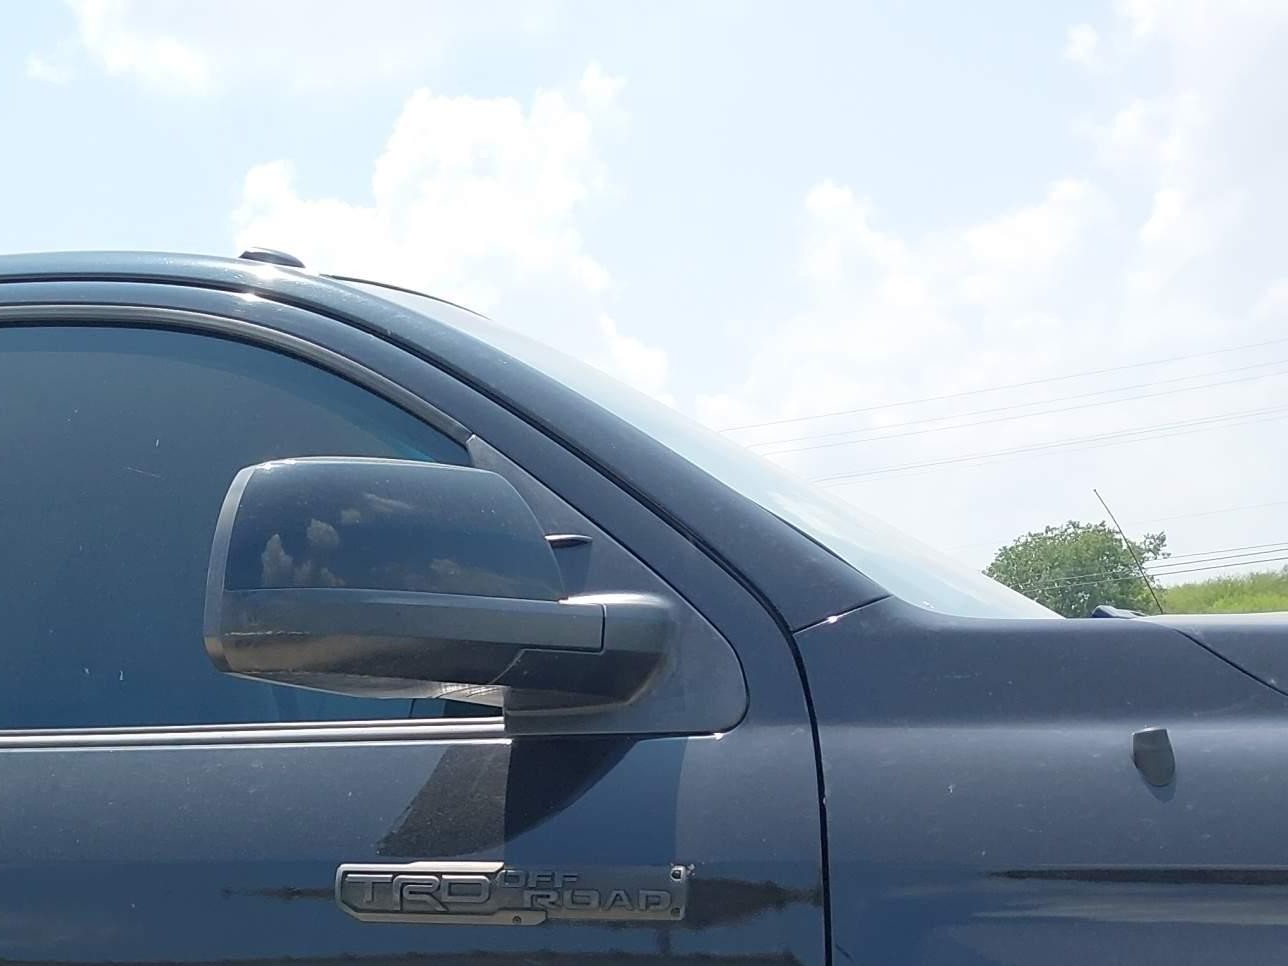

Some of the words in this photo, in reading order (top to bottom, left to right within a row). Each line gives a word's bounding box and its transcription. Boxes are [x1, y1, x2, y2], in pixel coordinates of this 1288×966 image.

[502, 869, 579, 889] OFF
[345, 873, 492, 912] TRD
[522, 889, 672, 911] ROAD
